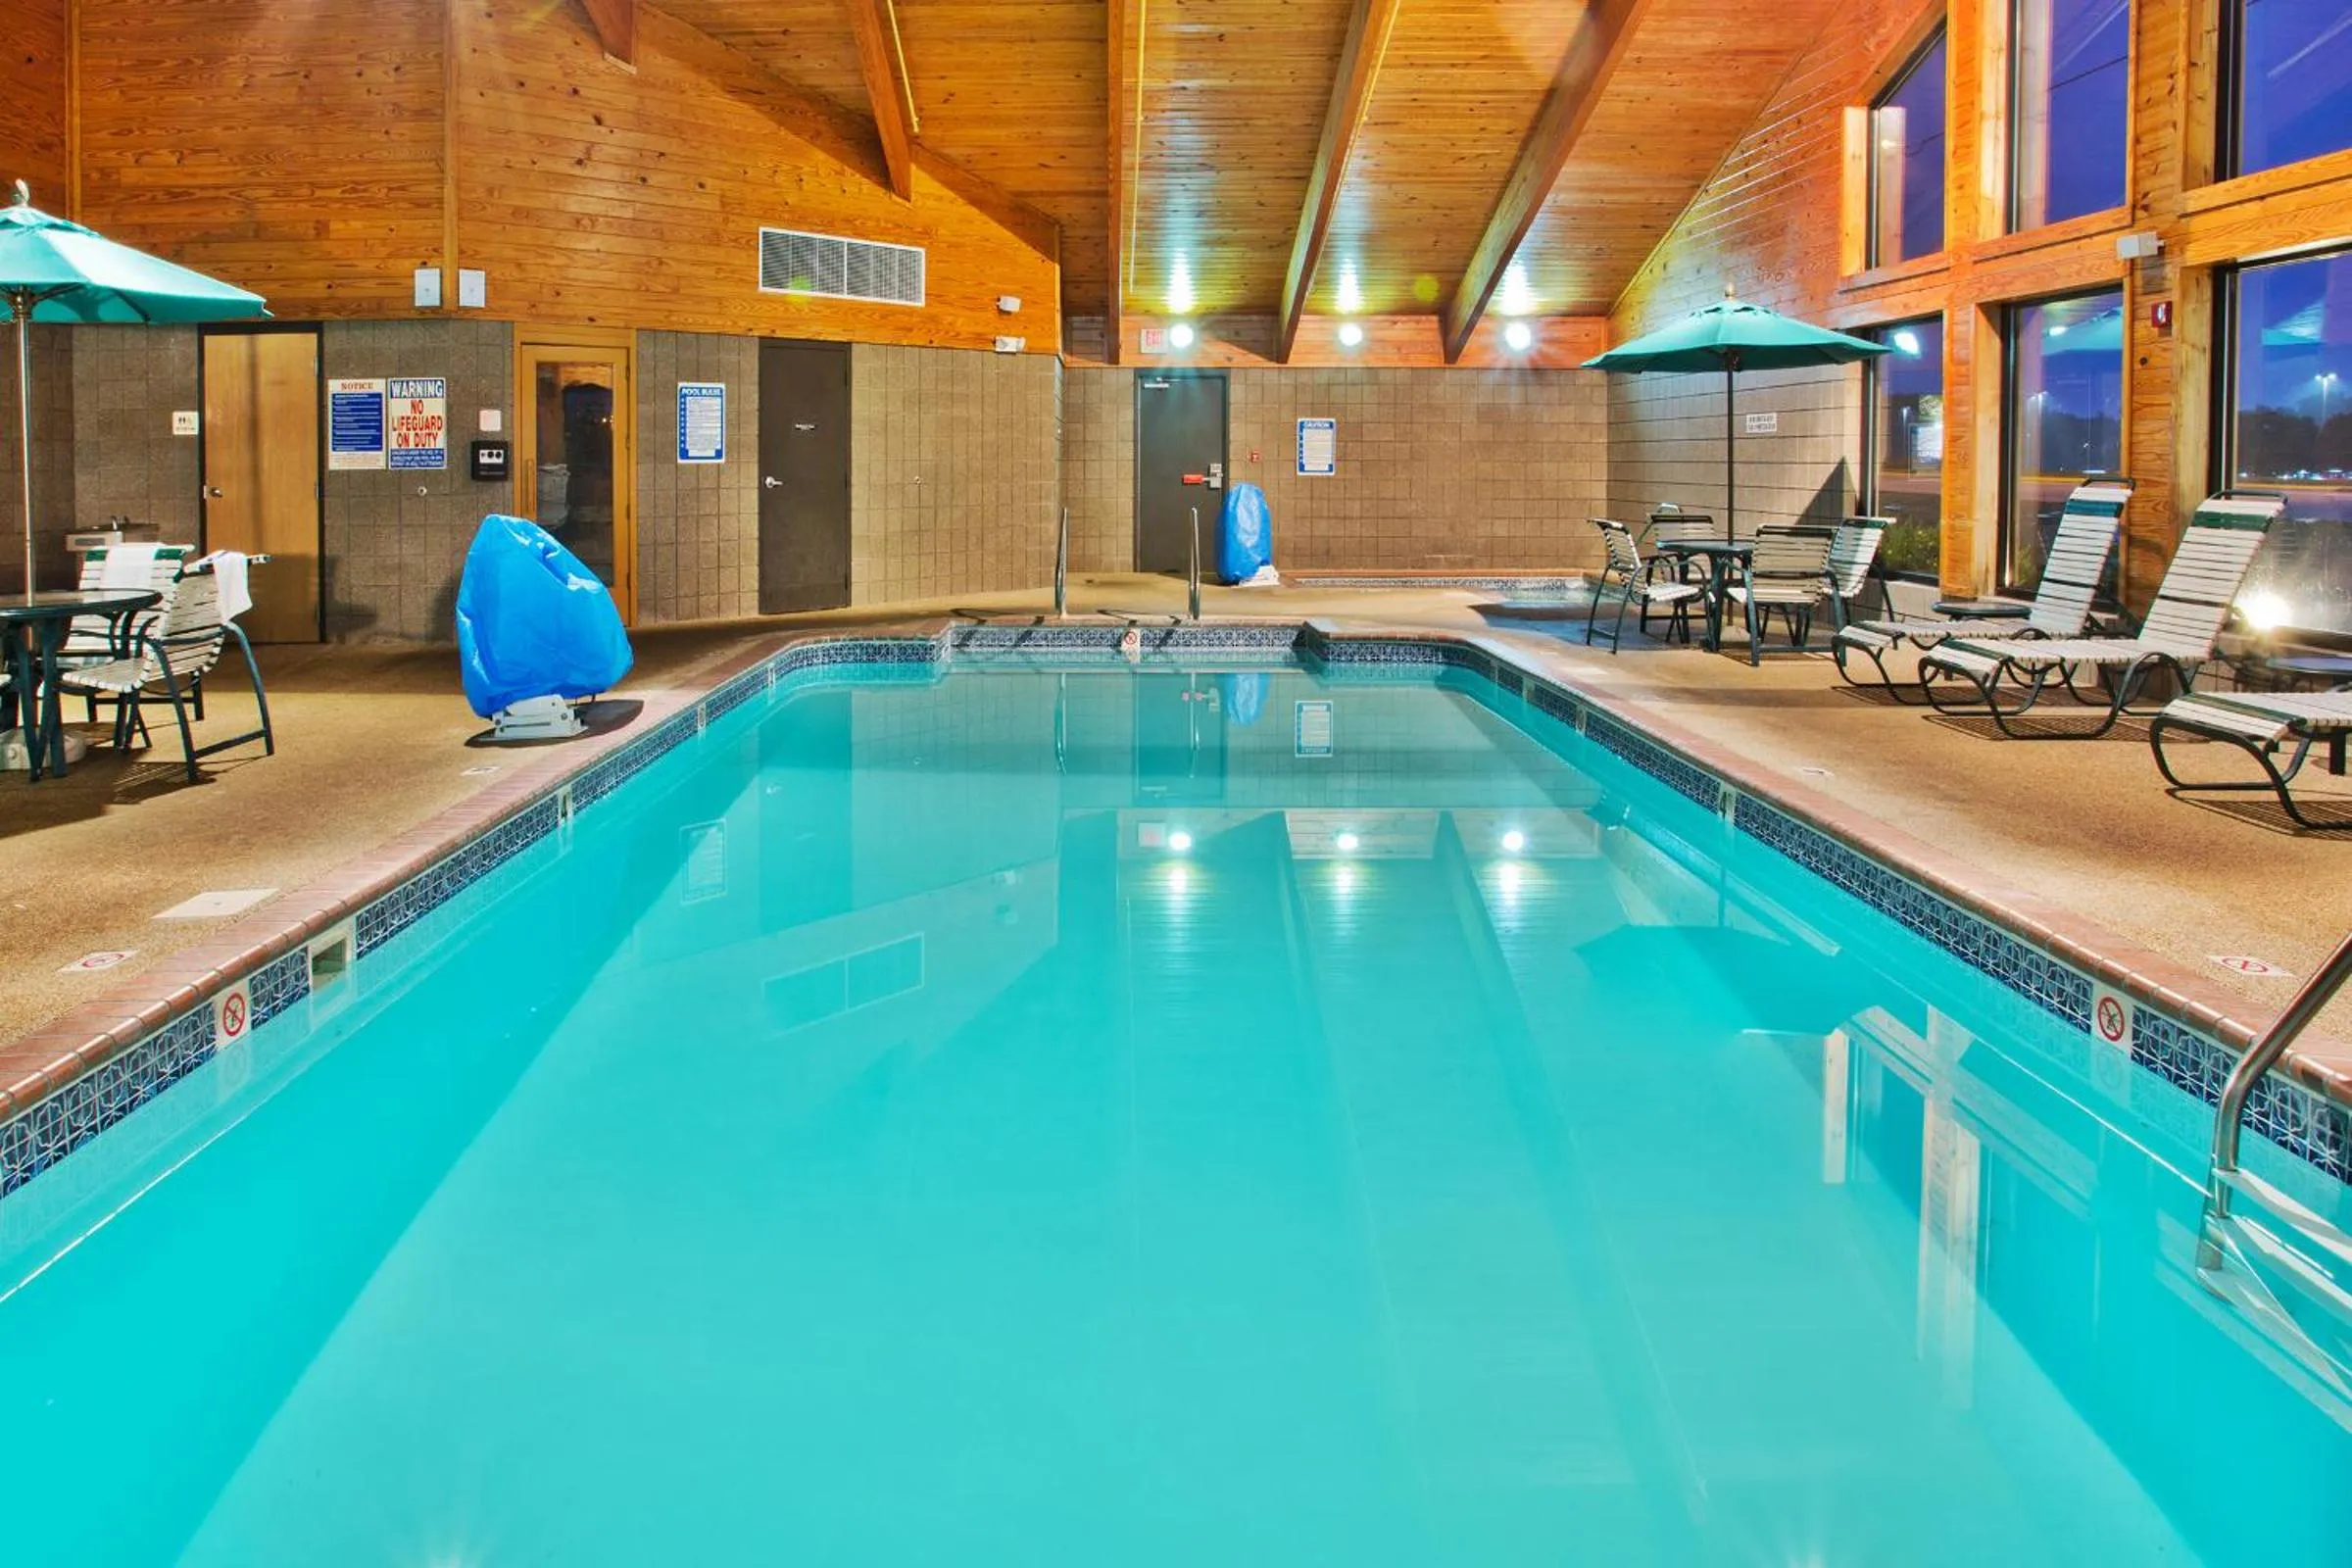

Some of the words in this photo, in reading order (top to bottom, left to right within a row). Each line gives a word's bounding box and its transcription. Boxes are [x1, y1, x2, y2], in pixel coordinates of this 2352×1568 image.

[392, 380, 443, 397] WARNING
[410, 399, 424, 415] NO
[392, 416, 443, 431] LIFEGUARD
[396, 432, 410, 447] ON
[414, 432, 438, 447] DUTY
